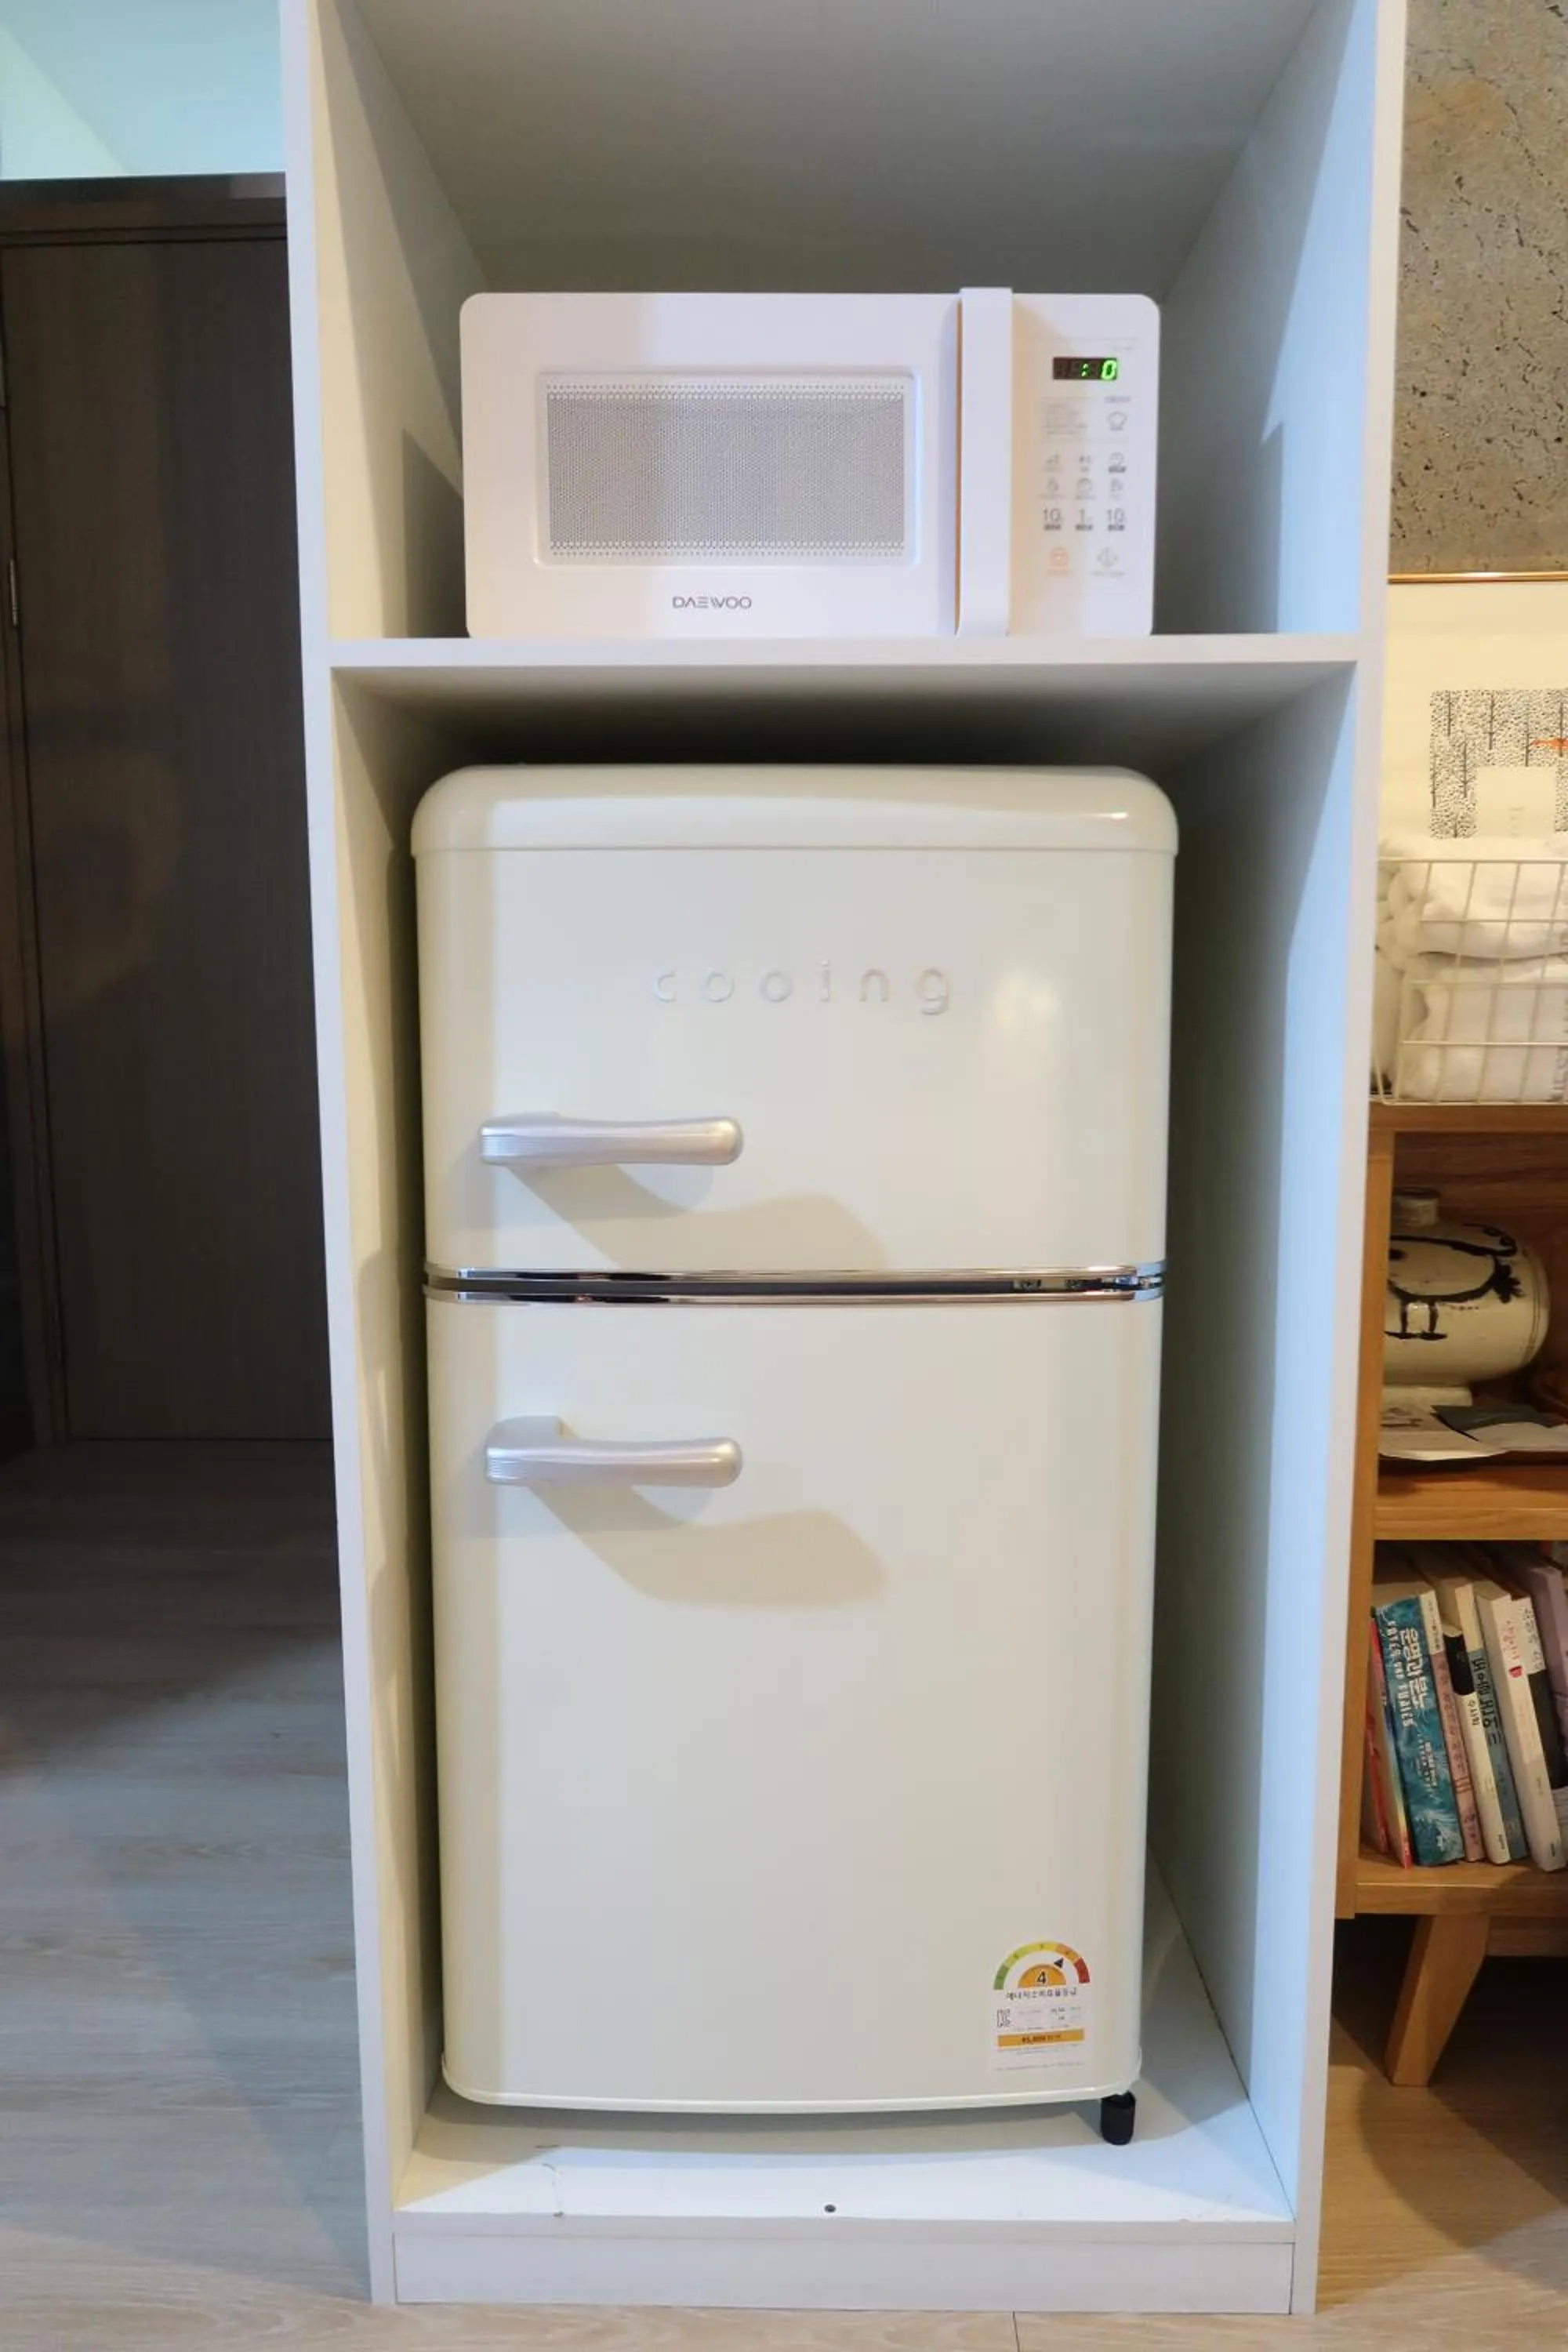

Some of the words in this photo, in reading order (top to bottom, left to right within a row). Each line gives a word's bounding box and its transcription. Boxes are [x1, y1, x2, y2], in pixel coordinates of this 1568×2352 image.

[673, 597, 752, 608] DAEWOO
[652, 959, 951, 1016] cooing
[1036, 1971, 1047, 1984] 4
